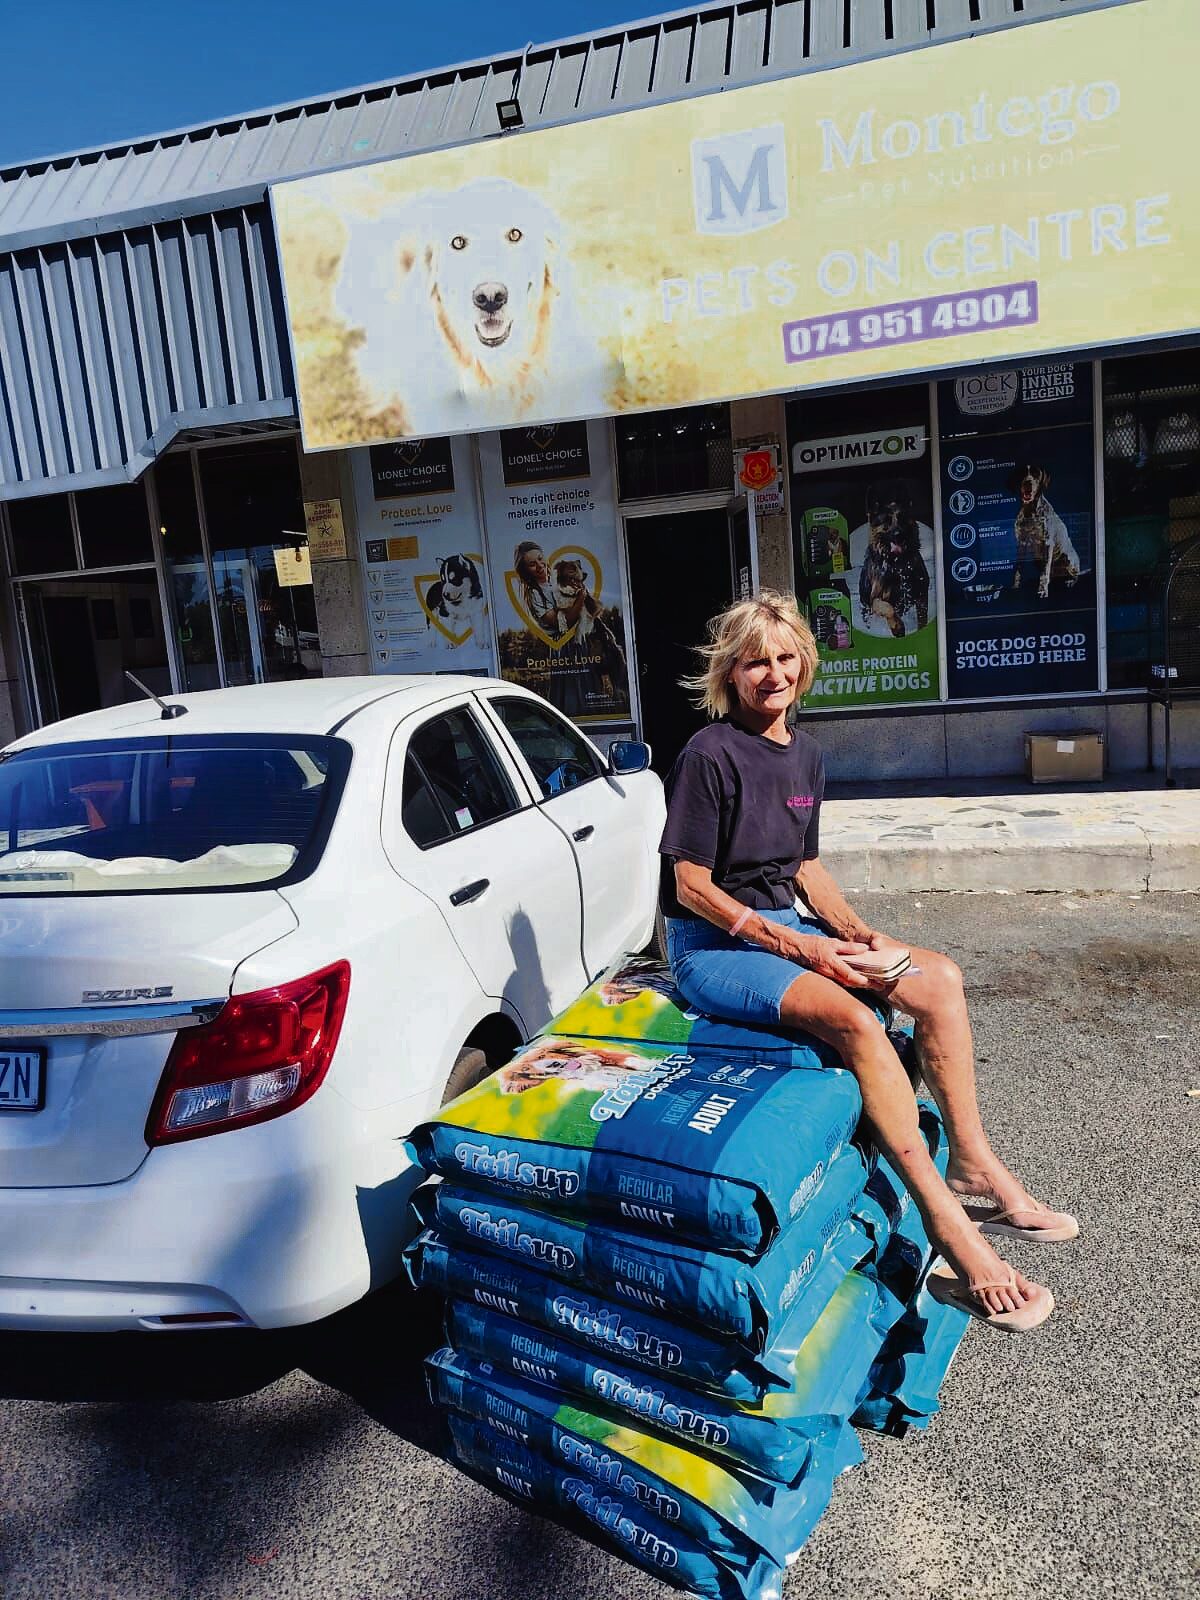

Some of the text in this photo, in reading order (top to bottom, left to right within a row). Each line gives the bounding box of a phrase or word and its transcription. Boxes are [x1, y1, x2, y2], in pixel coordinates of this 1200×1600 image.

[817, 80, 1120, 173] Montego
[702, 144, 778, 220] M
[659, 193, 1170, 323] PETS ON CENTRE
[789, 289, 1031, 355] 074 951 4904
[1022, 363, 1075, 377] YOUR DOG'S
[1022, 372, 1075, 390] INNER
[961, 373, 1014, 400] JOCK
[1022, 385, 1075, 401] LEGEND
[545, 448, 583, 461] CHOICE
[800, 435, 918, 464] OPTIMIZOR
[412, 464, 447, 477] CHOICE
[426, 503, 454, 516] Love
[508, 501, 596, 520] makes a lifetime's
[509, 488, 591, 507] The right choice
[525, 516, 580, 532] difference.
[956, 633, 1086, 654] JOCK DOG FOOD
[575, 654, 602, 665] Love
[821, 654, 918, 674] MORE PROTEIN
[956, 648, 1087, 669] STOCKED HERE
[810, 671, 930, 696] ACTIVE DOGS
[82, 985, 174, 1003] DZIRE
[643, 1080, 669, 1101] DOG
[665, 1067, 692, 1087] FOOD
[661, 1088, 705, 1125] REGULAR
[688, 1093, 737, 1135] ADULT
[454, 1142, 580, 1198] Tailsup
[618, 1173, 674, 1205] REGULAR
[459, 1207, 576, 1269] Tailsup
[612, 1255, 666, 1291] REGULAR
[552, 1295, 683, 1370] Tailsup
[511, 1333, 558, 1363] REGULAR
[486, 1393, 528, 1428] REGULAR
[593, 1369, 730, 1447] Tailsup
[559, 1435, 681, 1520] Tailsup
[561, 1477, 678, 1568] Tailsup
